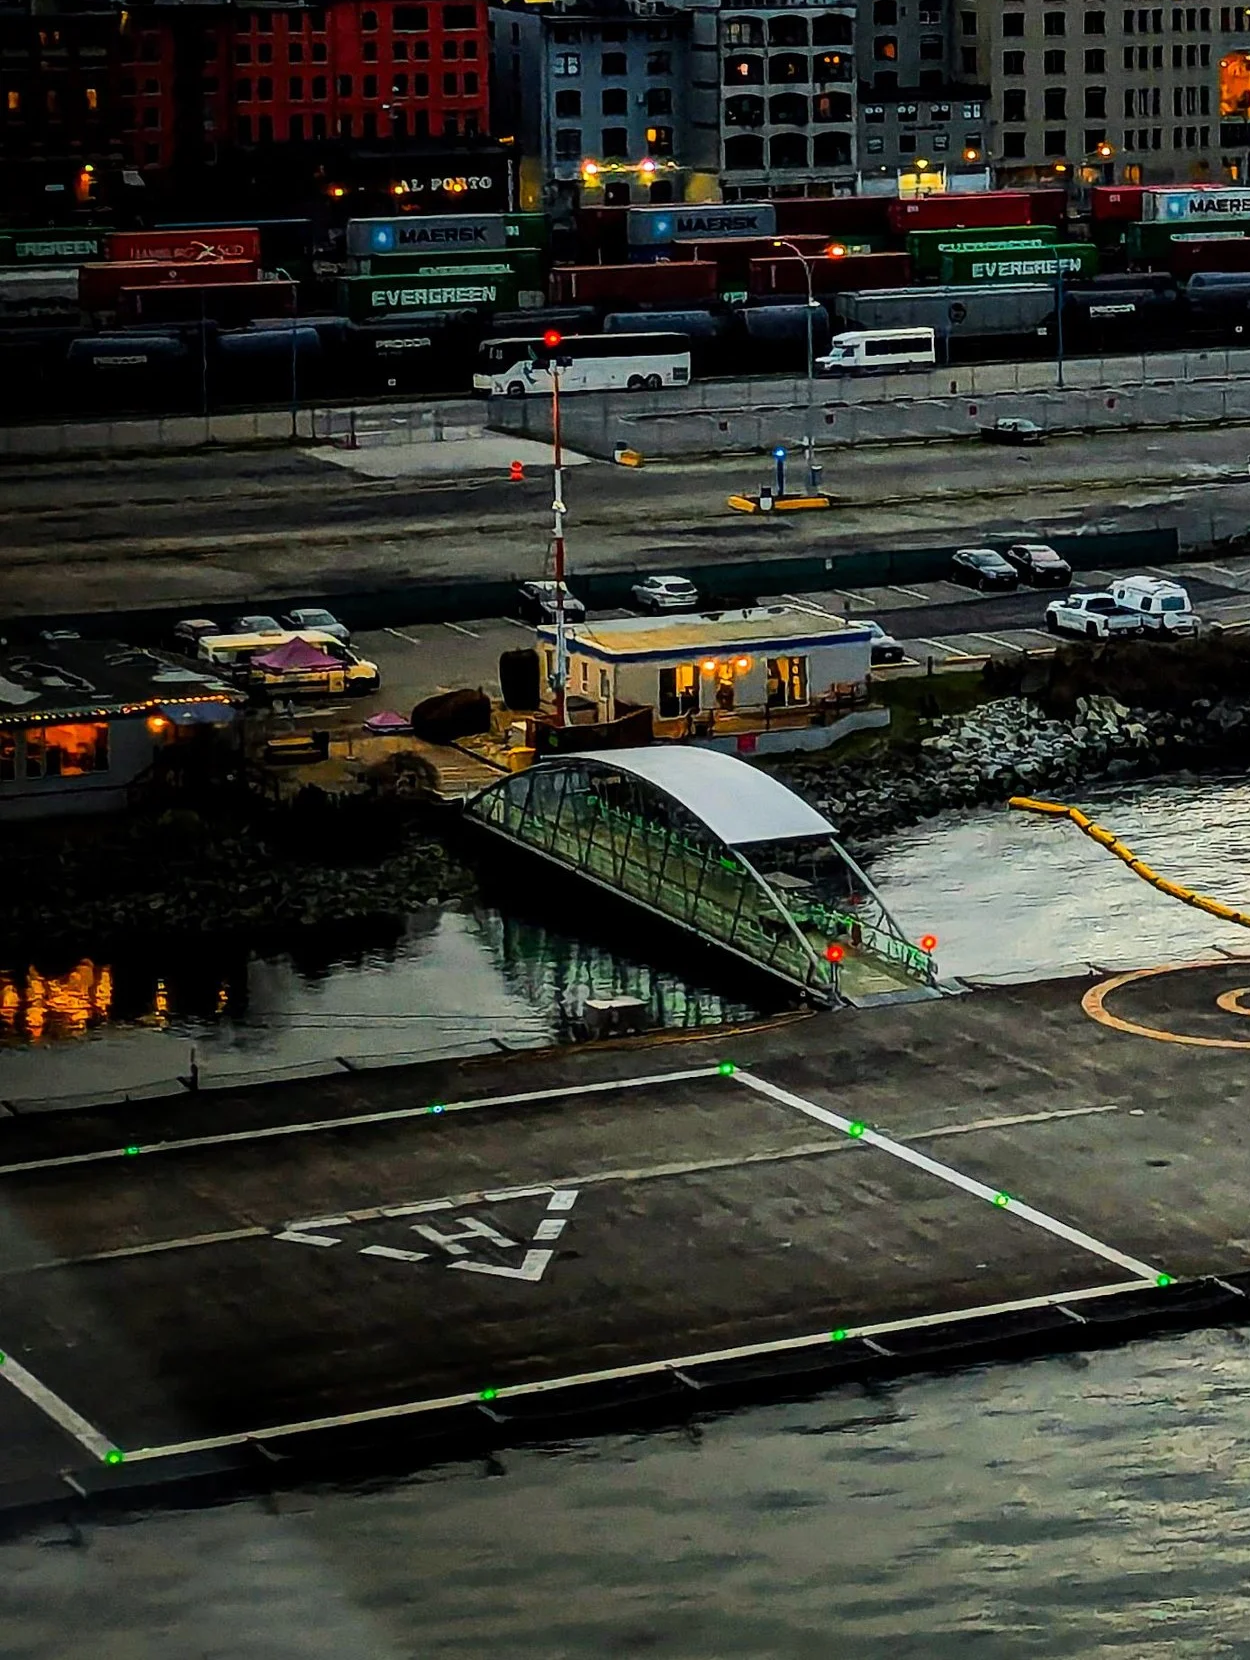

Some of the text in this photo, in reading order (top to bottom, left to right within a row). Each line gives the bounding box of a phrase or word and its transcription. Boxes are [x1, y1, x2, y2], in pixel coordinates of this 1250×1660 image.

[399, 225, 489, 244] MAERSK
[677, 216, 758, 233] MAERSK
[972, 257, 1082, 279] EVERGREEN
[371, 285, 497, 307] EVERGREEN
[410, 1217, 520, 1255] H
